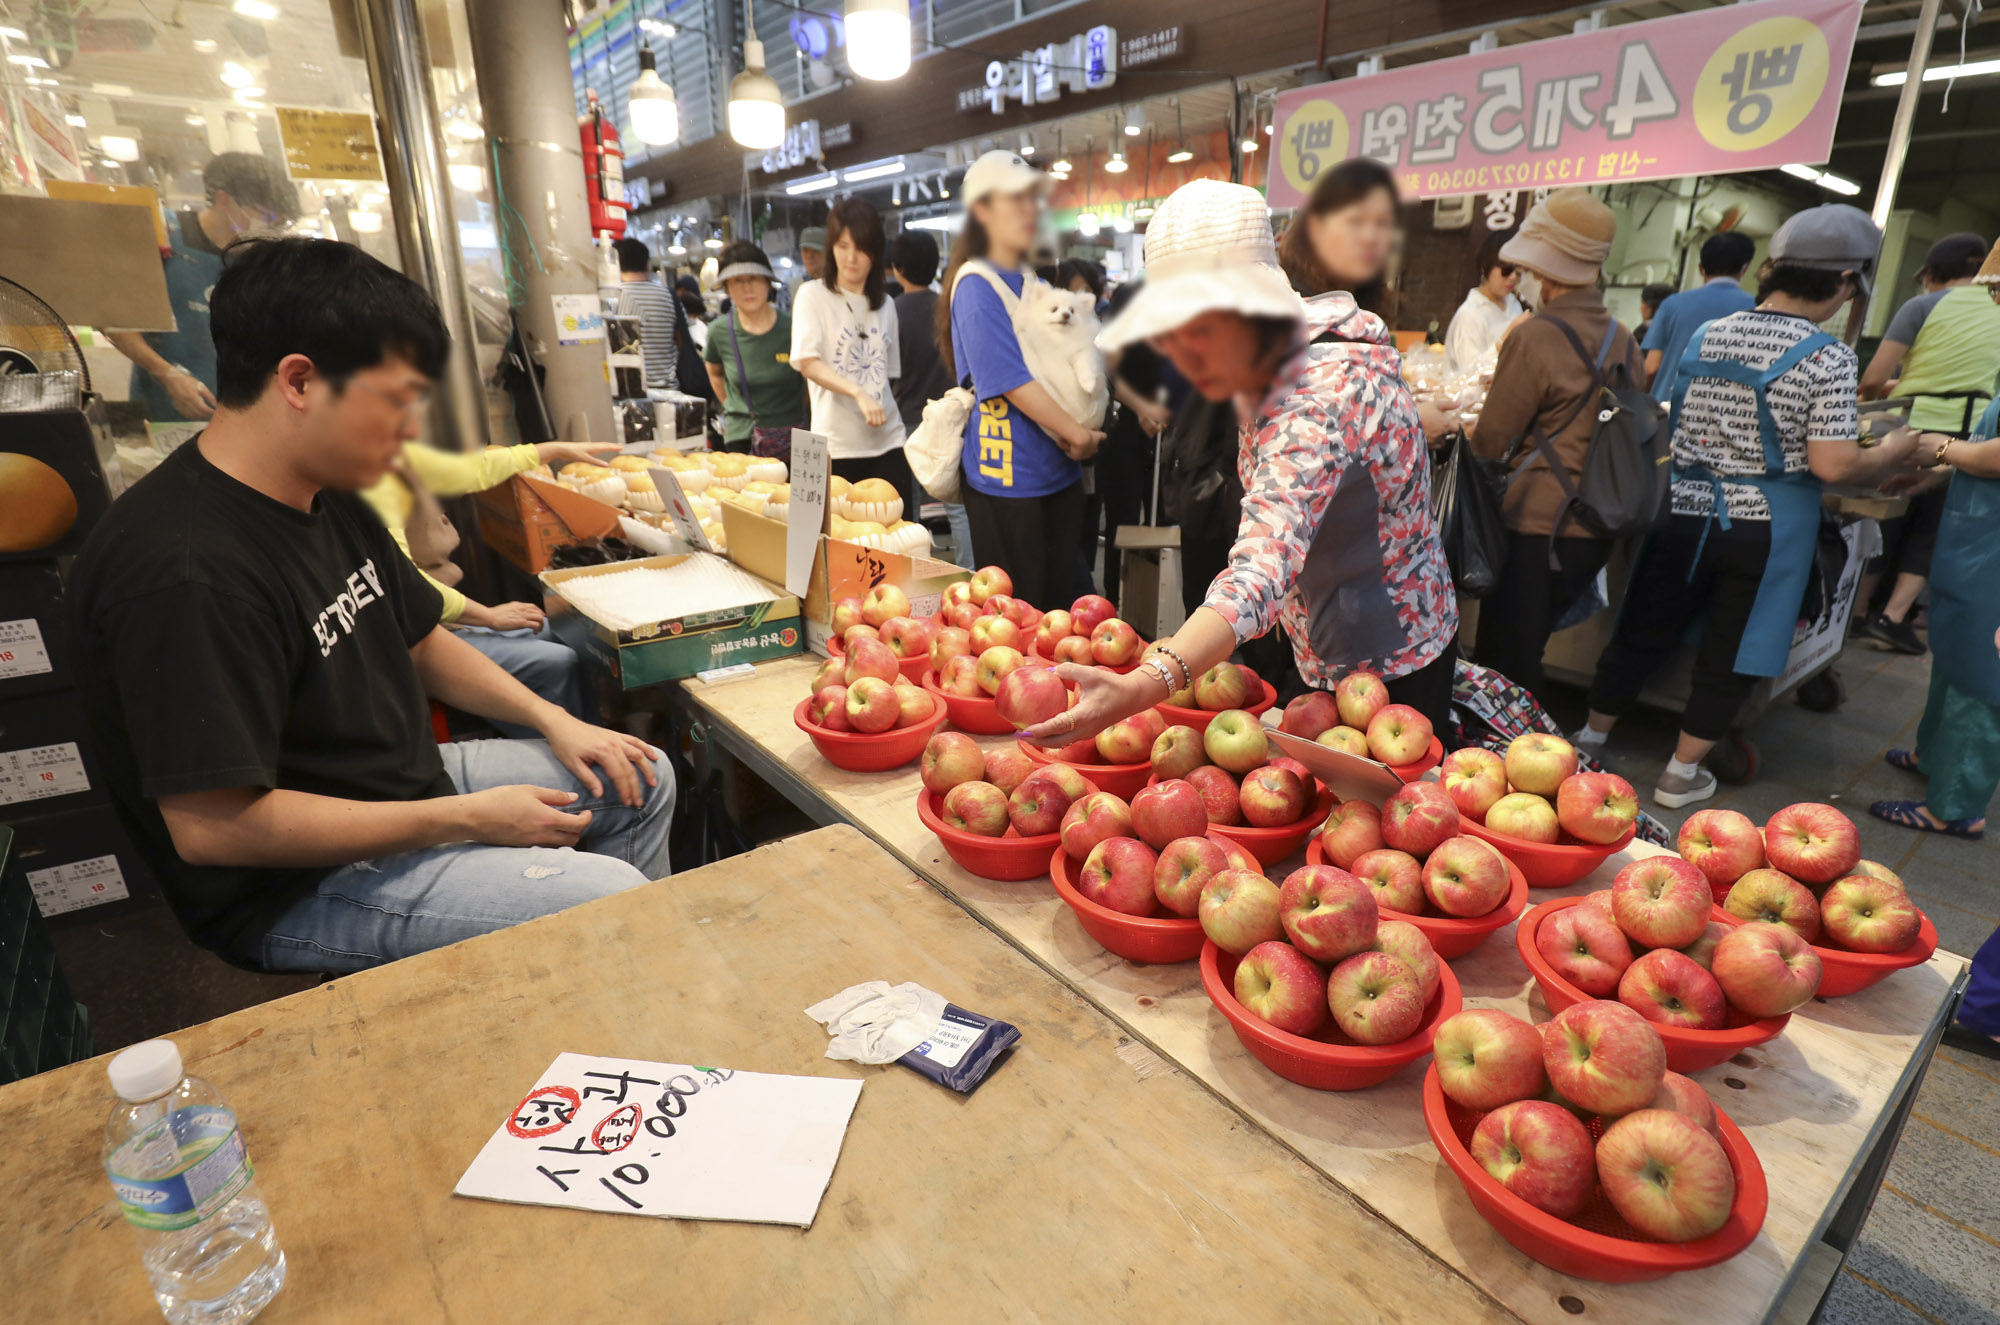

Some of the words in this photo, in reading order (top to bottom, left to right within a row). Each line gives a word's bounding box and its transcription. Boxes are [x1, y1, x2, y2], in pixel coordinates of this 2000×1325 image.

[40, 771, 55, 781] 18
[91, 883, 106, 893] 18
[536, 1071, 661, 1193] 사과
